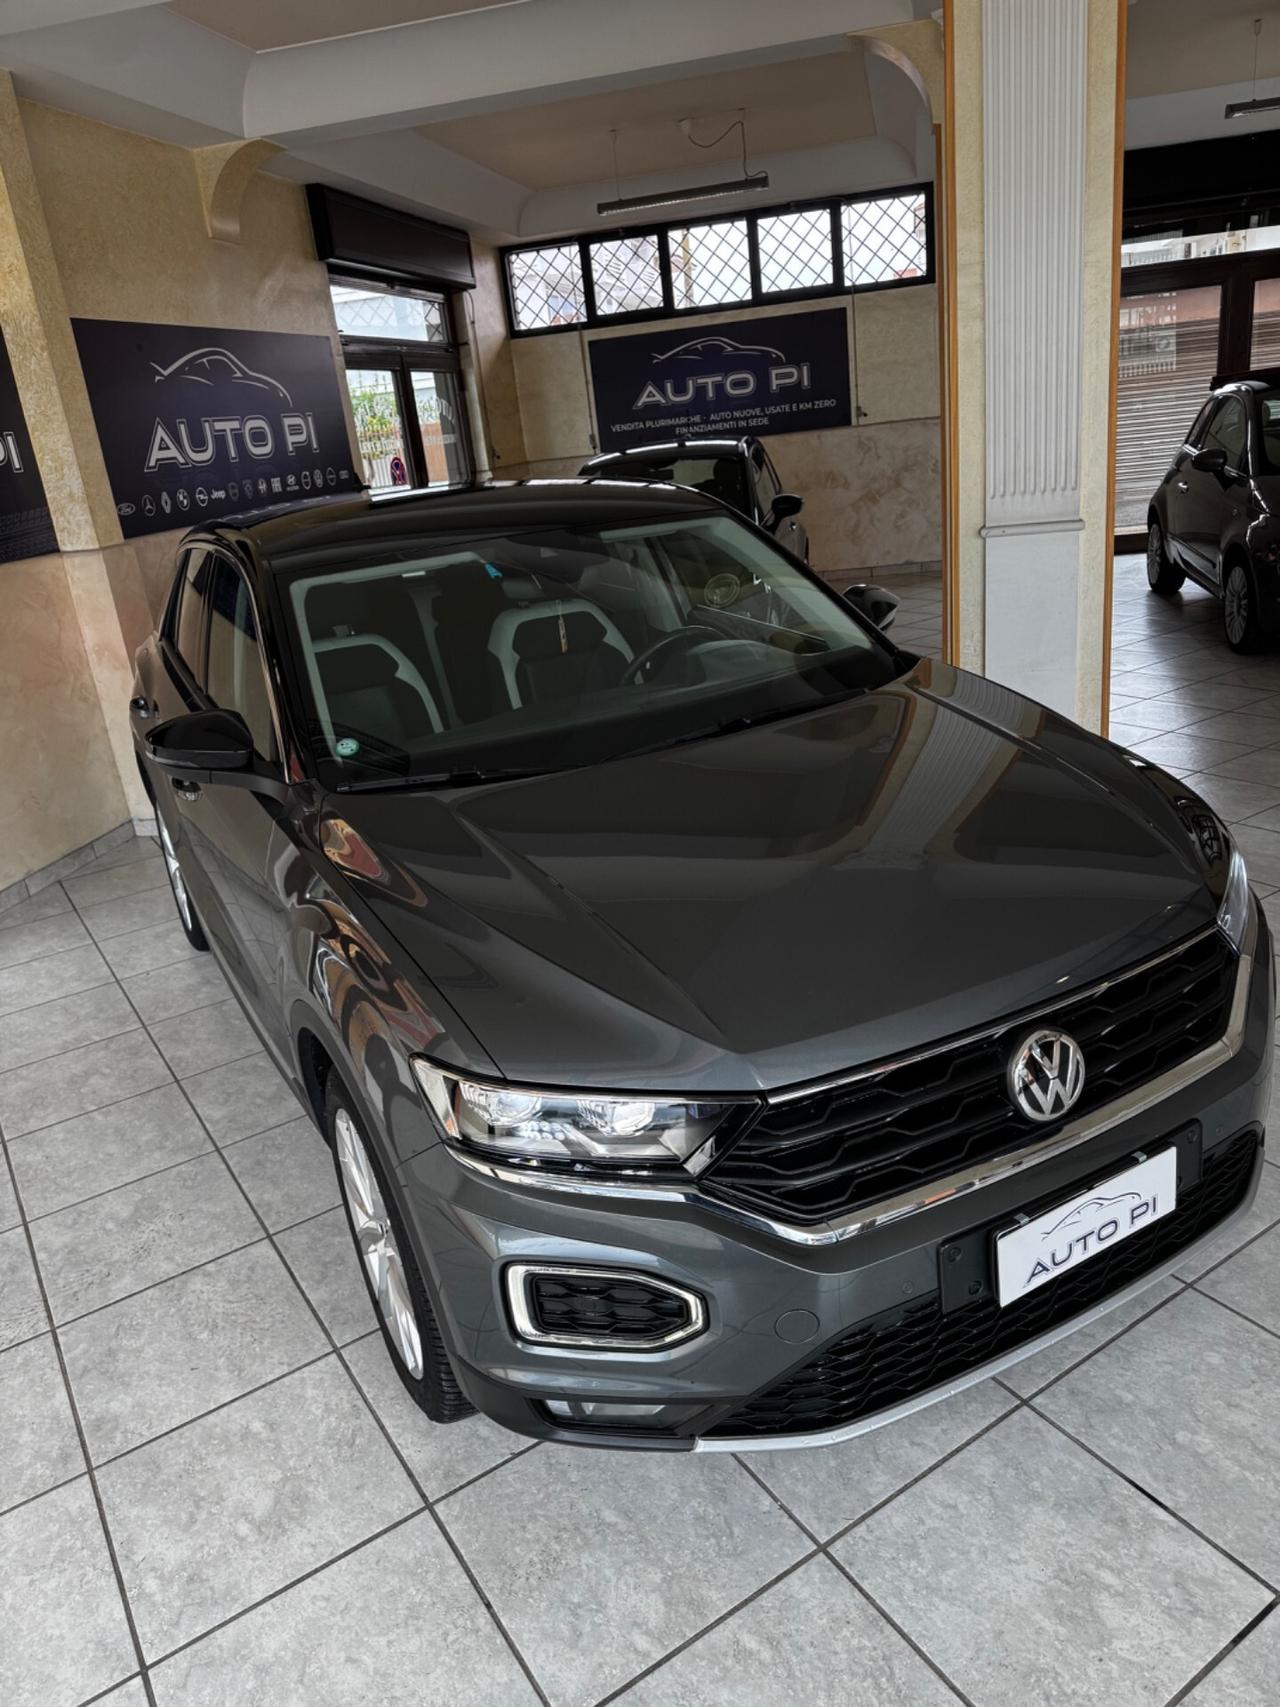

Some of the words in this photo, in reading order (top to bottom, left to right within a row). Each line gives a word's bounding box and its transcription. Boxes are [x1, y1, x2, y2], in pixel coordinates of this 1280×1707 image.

[632, 371, 757, 409] AUTO
[769, 362, 810, 393] PI
[610, 422, 644, 433] VENDITA
[645, 414, 702, 429] PLURIMARCHE
[709, 411, 732, 421] AUTO
[733, 407, 764, 418] NUOVE,
[765, 403, 791, 414] USATE
[792, 402, 798, 412] E
[799, 401, 812, 410] KM
[813, 398, 836, 409] ZERO
[675, 421, 737, 435] FINANZIAMENTI
[738, 418, 748, 428] IN
[748, 416, 769, 427] SEDE
[144, 414, 272, 472] AUTO
[280, 412, 319, 455] PI
[1023, 1218, 1120, 1288] AUTO
[1129, 1193, 1158, 1229] PI
